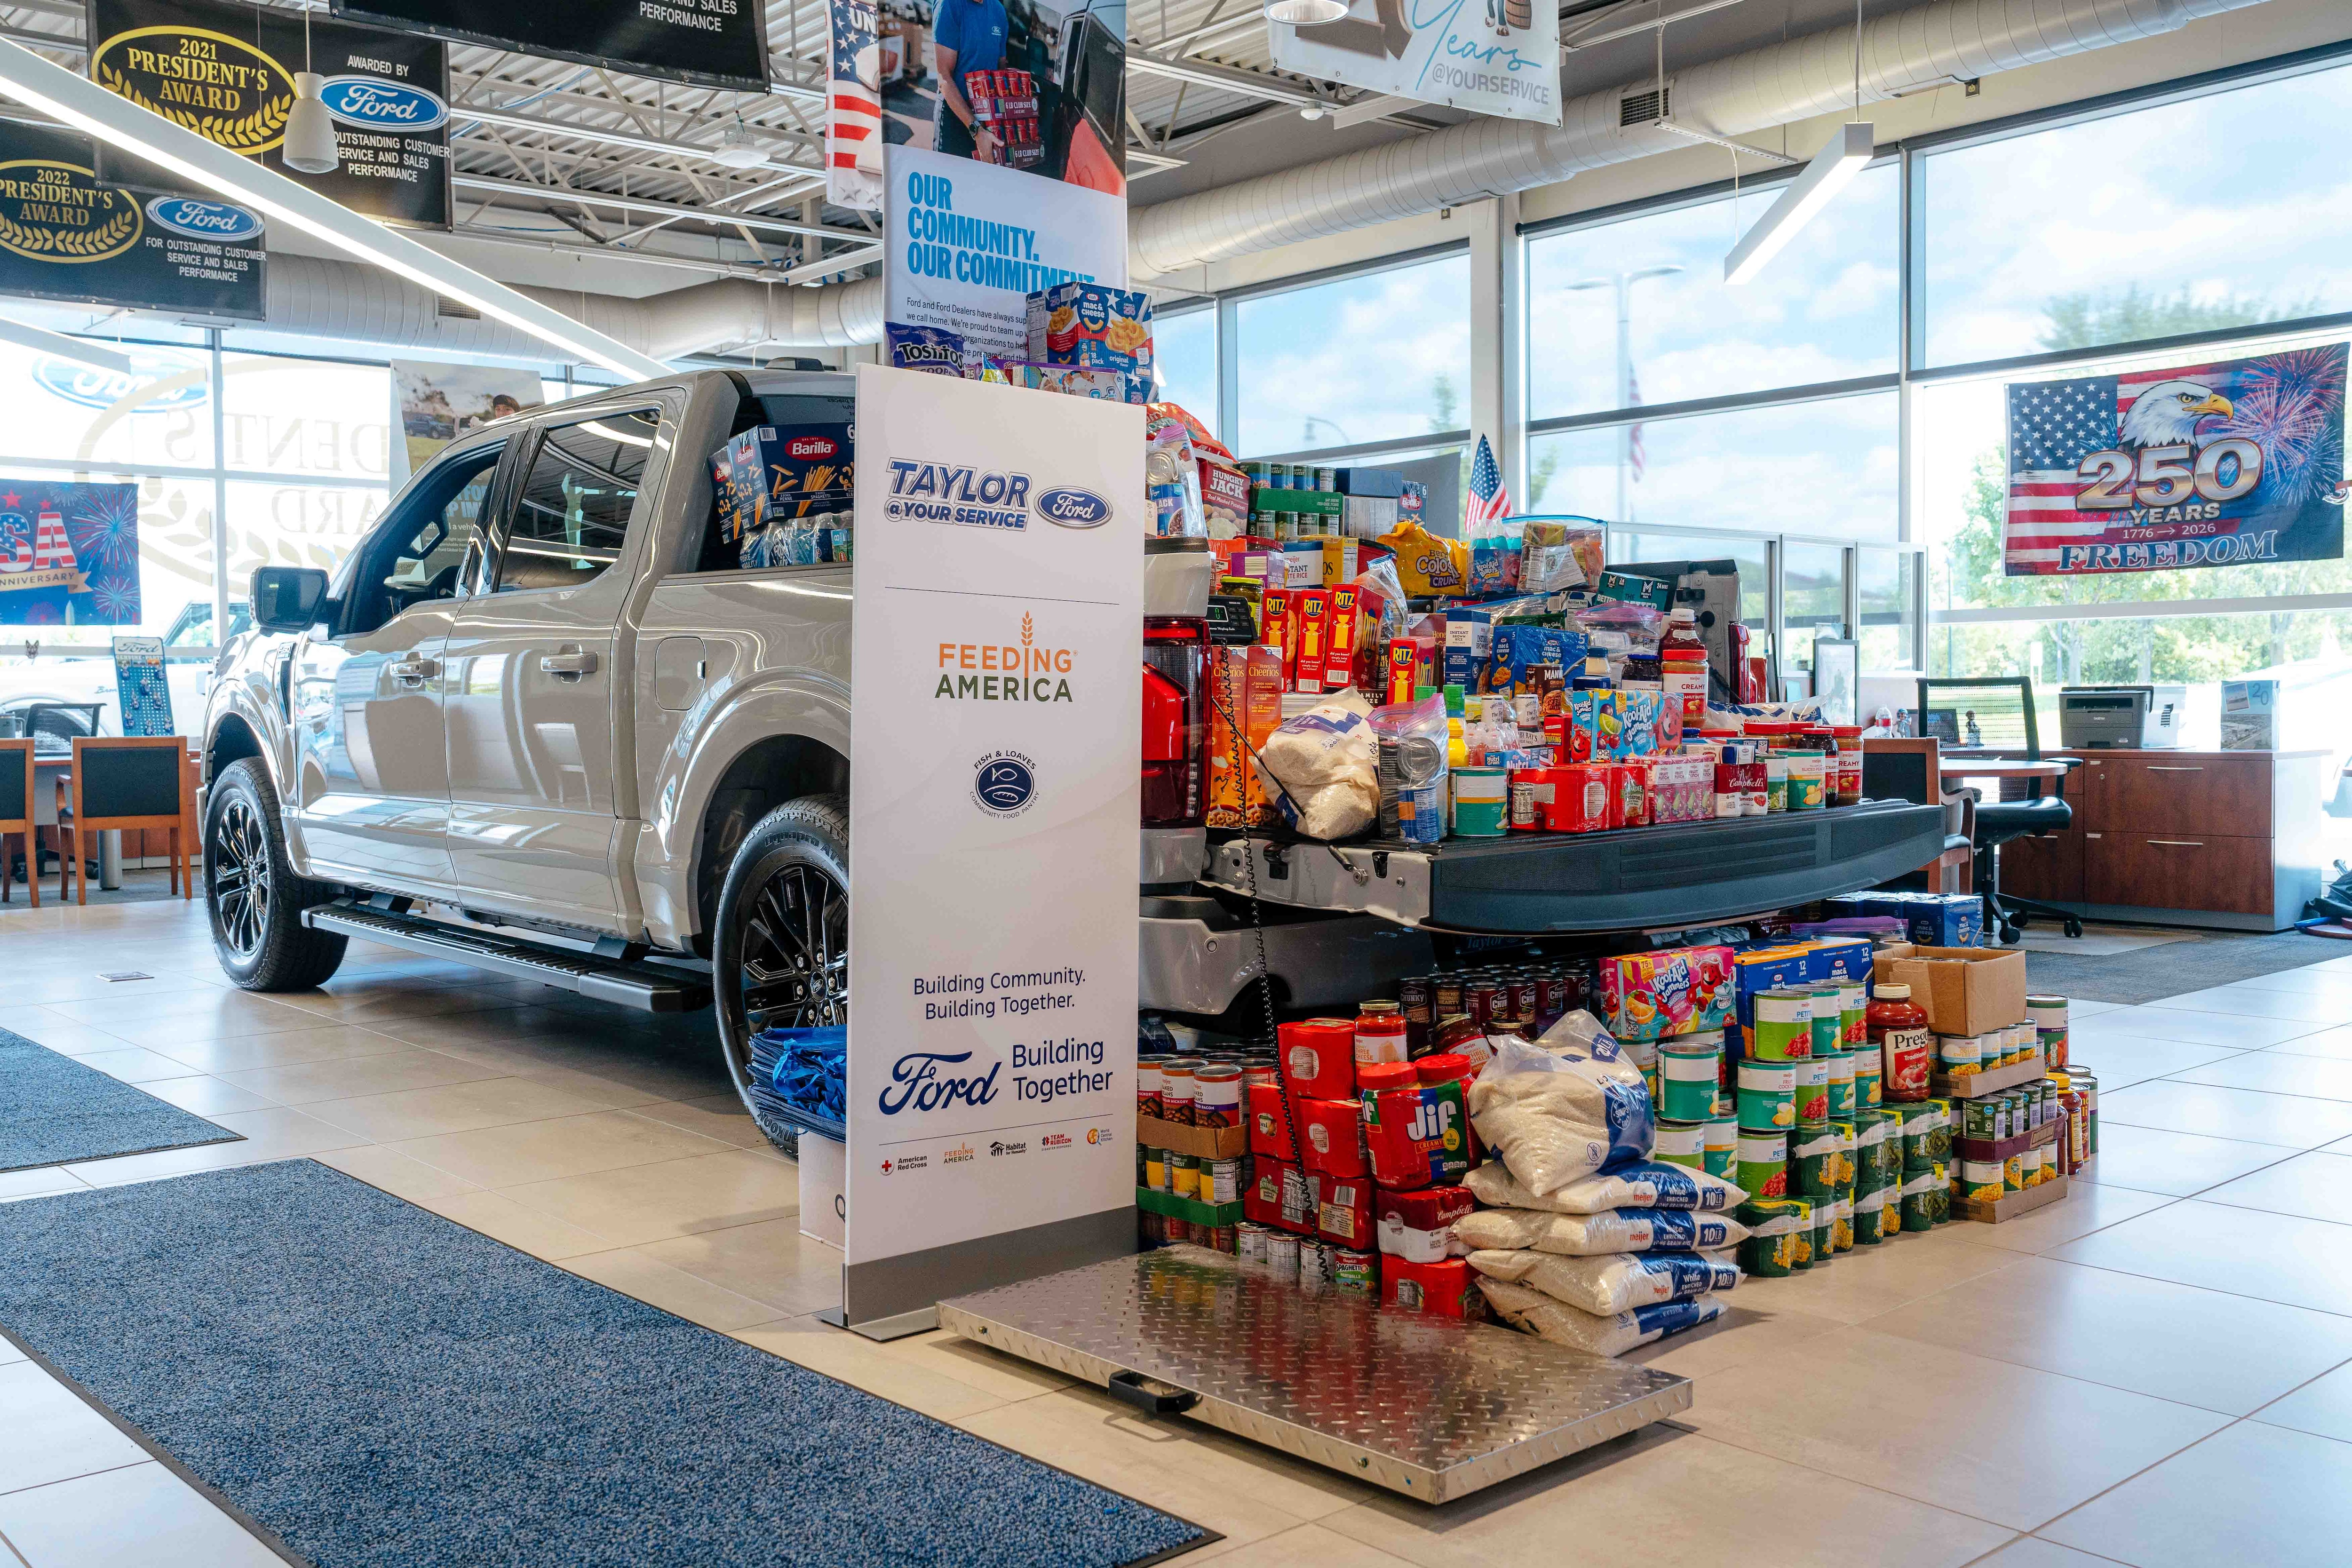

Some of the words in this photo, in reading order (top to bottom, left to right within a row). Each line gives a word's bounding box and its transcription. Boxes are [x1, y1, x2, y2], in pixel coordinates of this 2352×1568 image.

[640, 3, 722, 32] PERFORMANCE
[701, 0, 738, 15] SALES
[180, 38, 216, 60] 2021
[127, 47, 269, 92] PRESIDENT'S
[347, 55, 391, 73] AWARDED
[397, 64, 409, 76] BY
[1432, 63, 1549, 105] @YOURSERVICE
[159, 80, 241, 112] AWARD
[341, 85, 418, 119] Ford
[405, 139, 450, 158] CUSTOMER
[378, 152, 398, 163] AND
[404, 154, 429, 169] SALES
[37, 169, 70, 185] 2022
[348, 163, 417, 182] PERFORMANCE
[908, 172, 952, 210] OUR
[20, 203, 89, 226] AWARD
[175, 202, 238, 231] Ford
[908, 207, 1040, 262] COMMUNITY.
[146, 237, 163, 249] FOR
[167, 239, 222, 255] OUTSTANDING
[225, 246, 267, 261] CUSTOMER
[167, 252, 201, 266] SERVICE
[204, 257, 220, 267] AND
[223, 260, 248, 271] SALES
[907, 242, 952, 280] OUR
[179, 266, 238, 282] PERFORMANCE
[907, 297, 921, 307] Ford
[923, 301, 935, 310] and
[937, 302, 950, 312] Ford
[953, 305, 976, 316] Dealers
[977, 309, 992, 318] have
[993, 311, 1014, 322] always
[930, 316, 949, 326] home.
[951, 318, 969, 328] We're
[970, 322, 988, 333] proud
[990, 325, 996, 333] to
[998, 326, 1014, 336] team
[1015, 329, 1023, 338] up
[964, 334, 1006, 348] organizations
[792, 442, 831, 455] Barilla
[891, 461, 1030, 508] TAYLOR
[1213, 470, 1244, 486] HUNGRY
[2076, 438, 2263, 510] 250
[1210, 477, 1244, 499] JACK
[1052, 494, 1096, 520] Ford
[1230, 501, 1245, 510] Potatoes
[2129, 502, 2220, 525] YEARS
[955, 507, 1026, 529] SERVICE
[2122, 527, 2153, 539] 1776
[2182, 523, 2216, 535] 2026
[2058, 530, 2278, 572] FREEDOM
[1266, 597, 1286, 612] RITZ
[1304, 599, 1323, 613] RITZ
[1335, 591, 1355, 606] RITZ
[118, 642, 159, 653] Ford
[1578, 633, 1585, 644] 5
[939, 643, 1072, 673] FEEDING
[1393, 647, 1413, 662] RITZ
[1249, 667, 1279, 677] Cheerios
[935, 674, 1073, 702] AMERICA
[1622, 699, 1651, 728] Kool-Aid
[974, 753, 992, 769] FISH
[1006, 750, 1036, 770] LOAVES
[969, 791, 1001, 819] COMMUNITY
[1022, 791, 1040, 814] PANTRY
[1861, 947, 1869, 956] 12
[1652, 958, 1688, 994] Kool-Aid
[1799, 961, 1806, 971] 12
[914, 974, 984, 995] Building
[991, 967, 1086, 990] Community.
[925, 999, 995, 1020] Building
[1001, 993, 1075, 1015] Together.
[1012, 1037, 1104, 1068] Building
[879, 1051, 1002, 1115] Ford
[1012, 1069, 1113, 1103] Together
[1406, 1100, 1457, 1140] Jif
[1006, 1142, 1026, 1151] Habitat
[1050, 1137, 1072, 1146] RUBICON
[898, 1155, 927, 1164] American
[944, 1148, 974, 1158] FEEDING
[944, 1155, 974, 1164] AMERICA
[898, 1162, 909, 1171] Red
[910, 1161, 928, 1169] Cross
[1634, 1194, 1653, 1202] meijer
[1630, 1232, 1649, 1242] meijer
[1683, 1273, 1700, 1282] White
